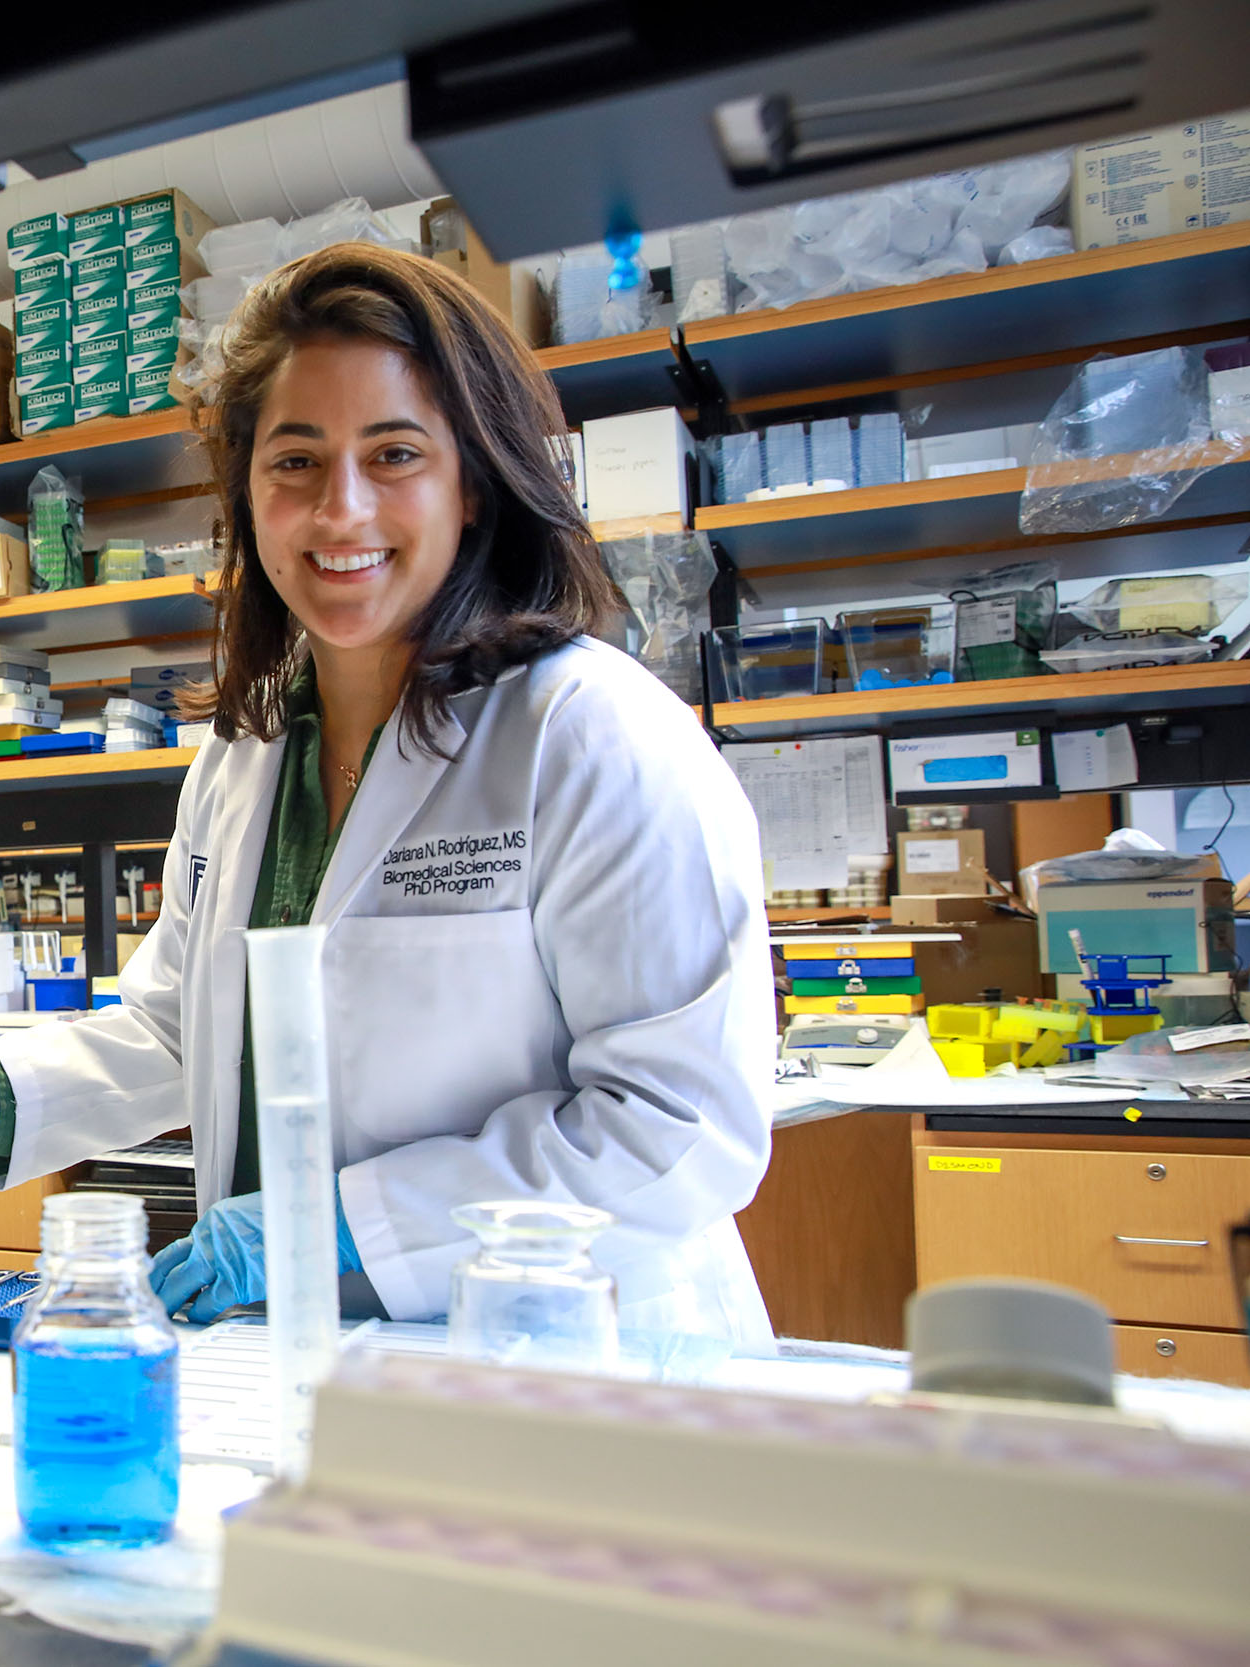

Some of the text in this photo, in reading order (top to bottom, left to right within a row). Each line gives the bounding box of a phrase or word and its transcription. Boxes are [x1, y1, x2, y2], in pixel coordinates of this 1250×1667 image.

[131, 201, 171, 216] KIMTECH
[13, 219, 51, 234] KIMTECH
[75, 212, 113, 228] KIMTECH
[132, 242, 173, 257] KIMTECH
[78, 256, 117, 271] KIMTECH
[21, 265, 58, 280] KIMTECH
[134, 285, 175, 300] KIMTECH
[78, 296, 117, 311] KIMTECH
[22, 307, 60, 322] KIMTECH
[79, 339, 119, 353] KIMTECH
[21, 349, 60, 363] KIMTECH
[81, 381, 120, 396] KIMTECH
[27, 392, 65, 406] KIMTECH
[425, 840, 437, 859] N.
[503, 830, 526, 849] MS
[383, 859, 522, 885] Biomedical Sciences
[404, 876, 495, 897] PhD Program
[1146, 888, 1194, 899] eppendorf
